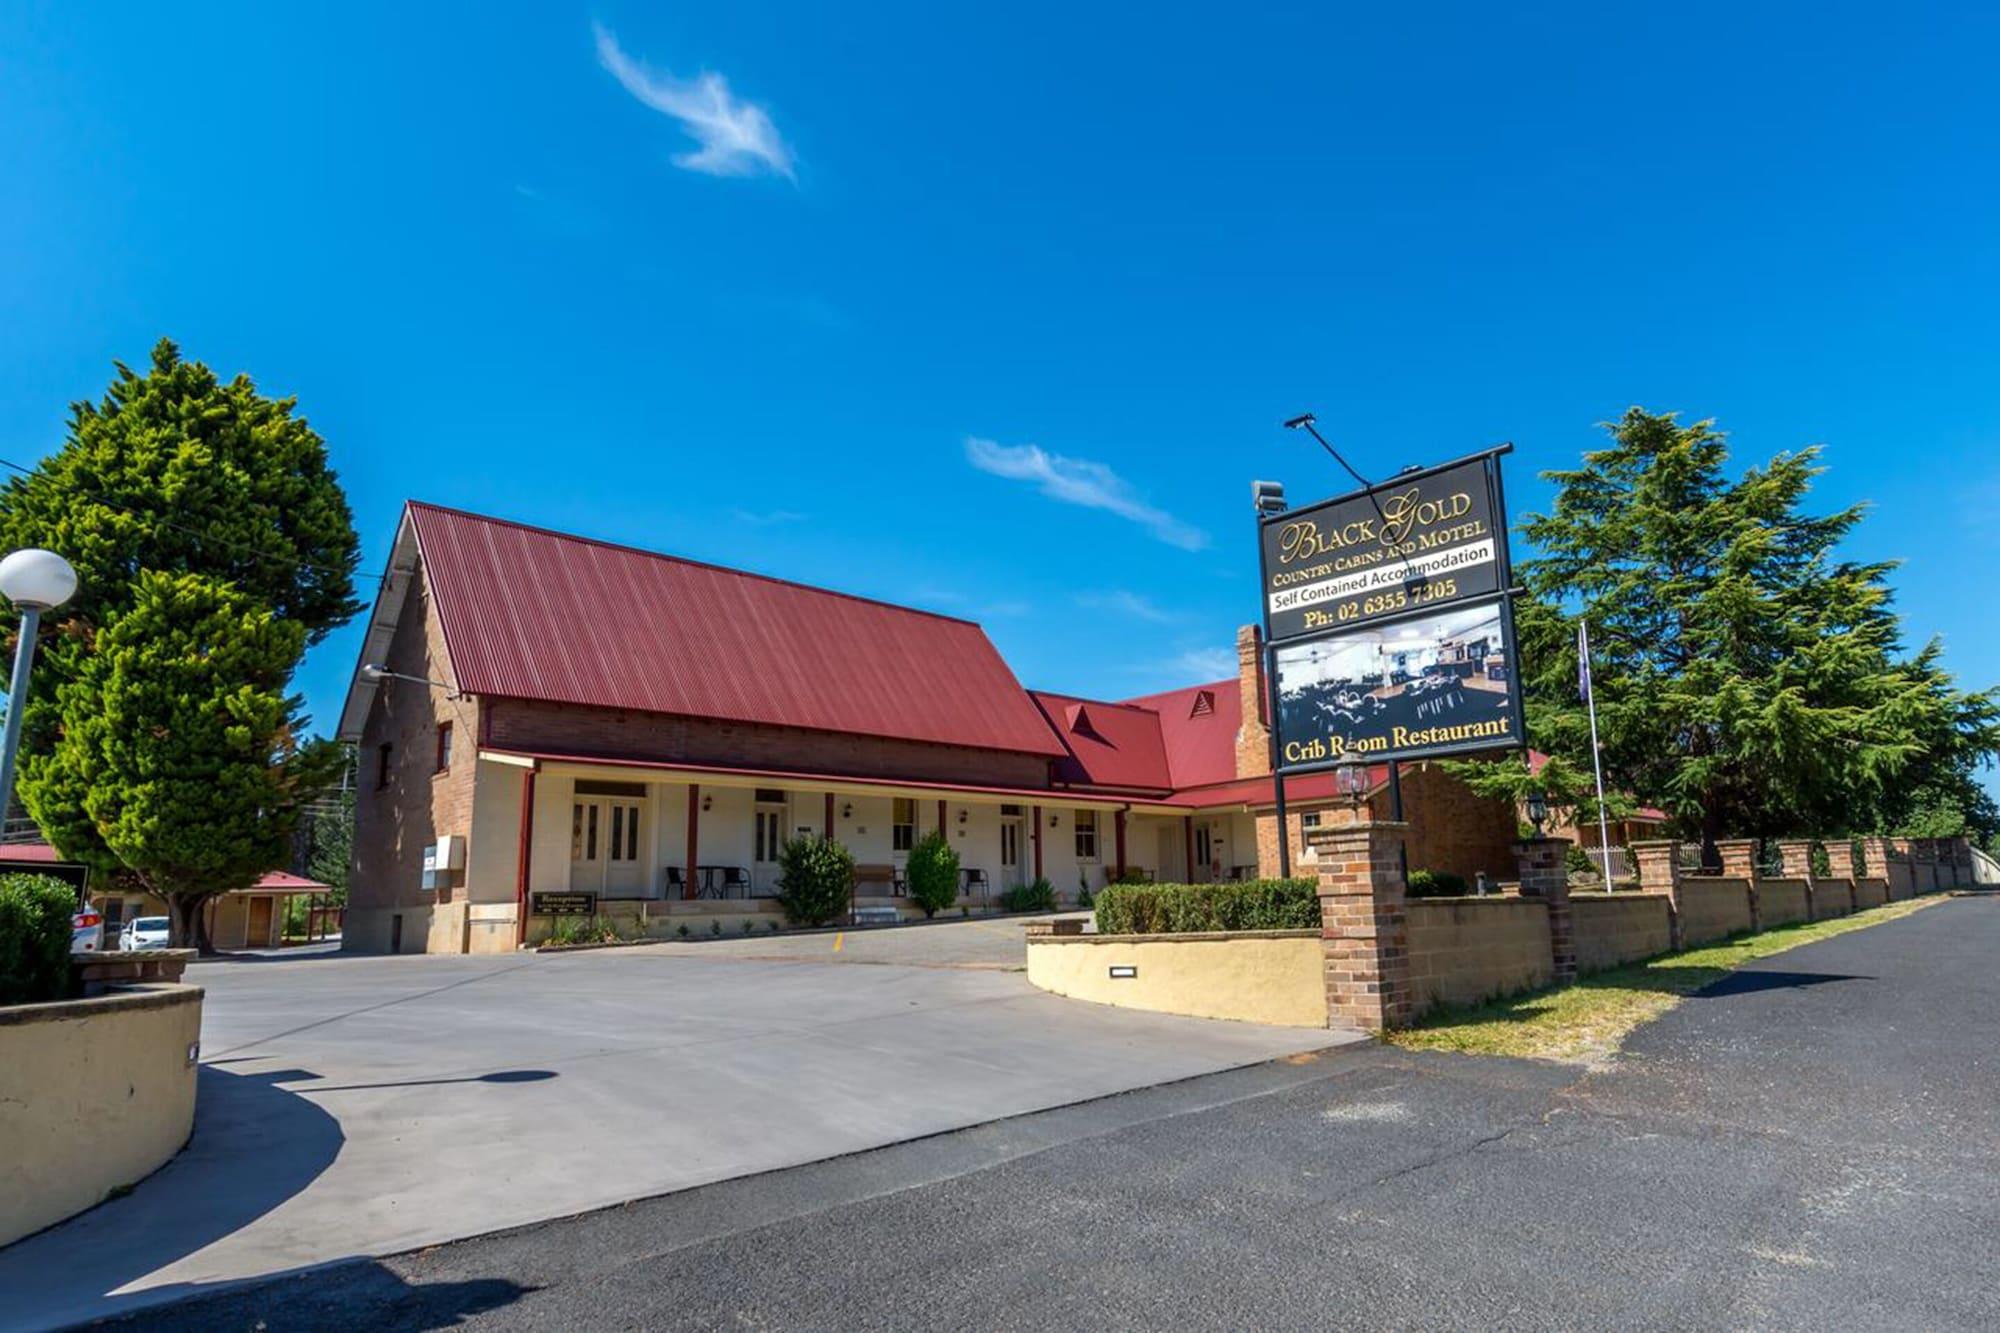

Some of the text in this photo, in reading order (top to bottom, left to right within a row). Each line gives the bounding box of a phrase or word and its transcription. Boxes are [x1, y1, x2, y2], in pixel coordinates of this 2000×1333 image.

[1273, 520, 1487, 587] COUNTRY CABINS AND MOTEL
[1279, 488, 1472, 563] BLACK GOLD
[1275, 547, 1488, 608] Self Contained Accommodation
[1304, 579, 1457, 628] Ph: 02 6355 7305
[1285, 738, 1326, 762] Crib
[1391, 716, 1509, 748] Restaurant
